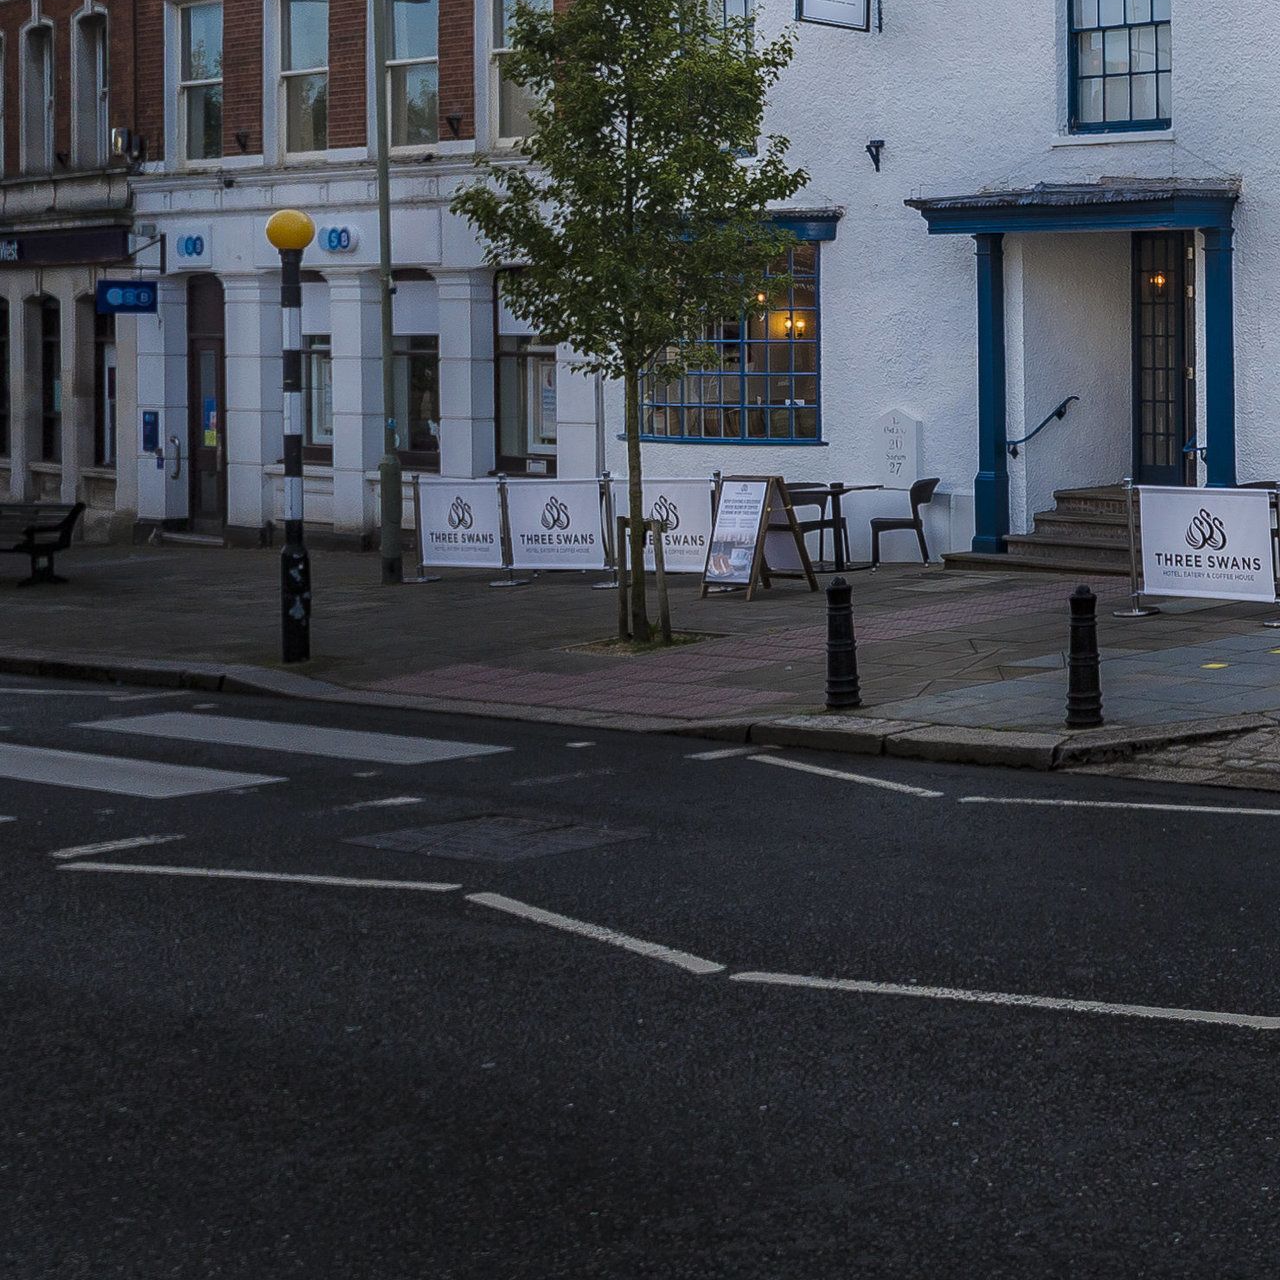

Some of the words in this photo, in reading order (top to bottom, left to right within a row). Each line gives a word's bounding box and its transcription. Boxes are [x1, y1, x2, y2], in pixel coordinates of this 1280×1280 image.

[889, 462, 902, 475] 27
[430, 532, 459, 544] THREE
[461, 533, 495, 544] SWANS
[520, 534, 554, 545] THREE
[556, 534, 595, 545] SWANS
[664, 534, 705, 546] SWANS
[1154, 552, 1203, 568] THREE
[1207, 555, 1262, 571] SWANS
[1212, 572, 1234, 580] COFFEE
